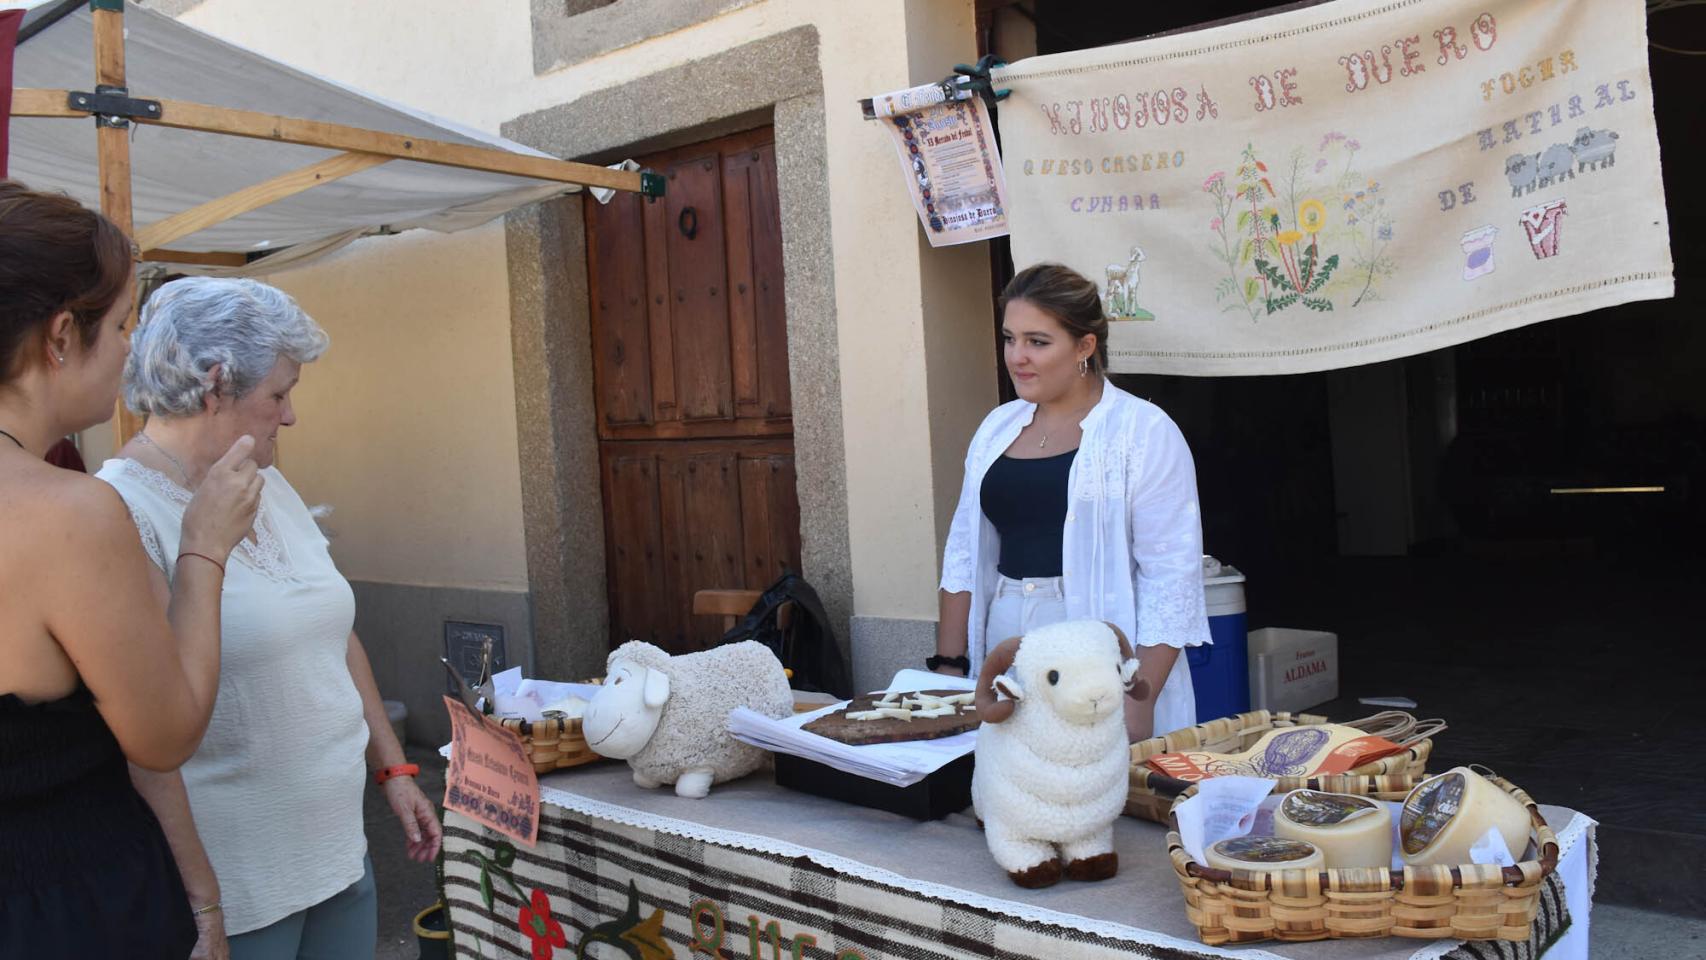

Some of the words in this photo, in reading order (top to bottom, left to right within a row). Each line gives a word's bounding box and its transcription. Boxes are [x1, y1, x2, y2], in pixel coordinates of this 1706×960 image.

[1249, 67, 1303, 112] DE
[1338, 12, 1497, 93] DUERO
[1023, 158, 1094, 176] QUESO
[1101, 150, 1185, 174] CASERO
[1438, 181, 1477, 212] DE
[968, 211, 976, 220] de
[975, 207, 997, 218] Duero
[1283, 660, 1327, 684] ALDAMA
